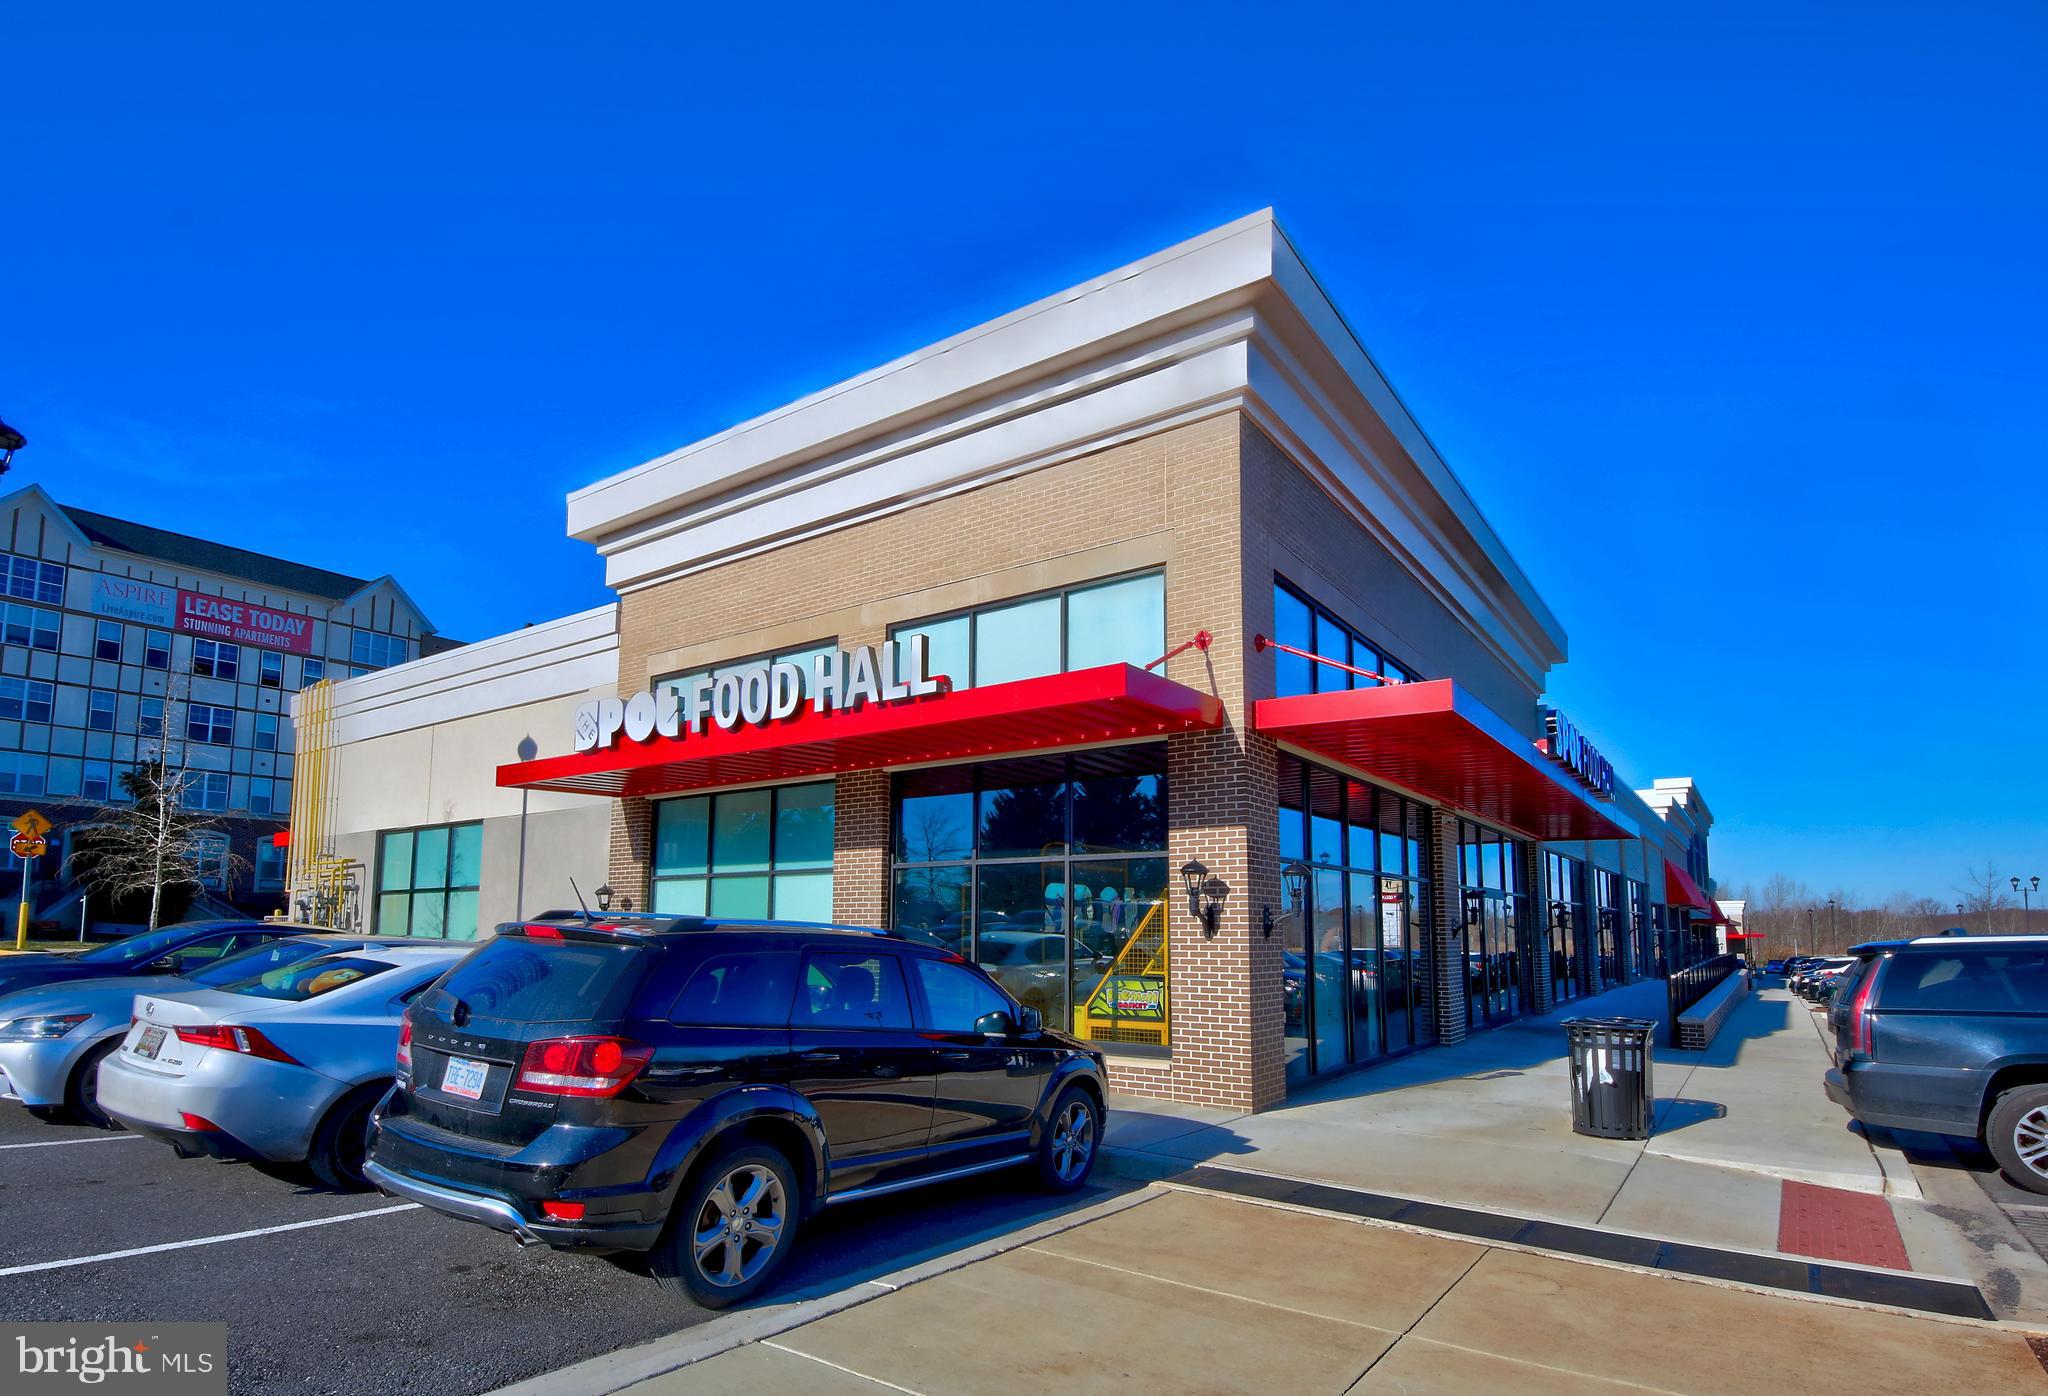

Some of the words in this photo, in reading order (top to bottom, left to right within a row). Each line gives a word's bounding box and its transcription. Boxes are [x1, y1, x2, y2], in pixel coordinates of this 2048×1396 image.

[95, 578, 169, 605] ASPIRE
[101, 602, 165, 623] LiveAspire.com
[184, 596, 243, 624] LEASE
[249, 609, 306, 636] TODAY
[183, 617, 231, 636] STUNNING
[233, 627, 291, 648] APARTMENTS
[690, 662, 802, 735] FOOD
[814, 633, 938, 713] HALL
[578, 711, 596, 740] THE
[427, 1034, 486, 1049] DODGE
[508, 1098, 555, 1109] CROSSROAD
